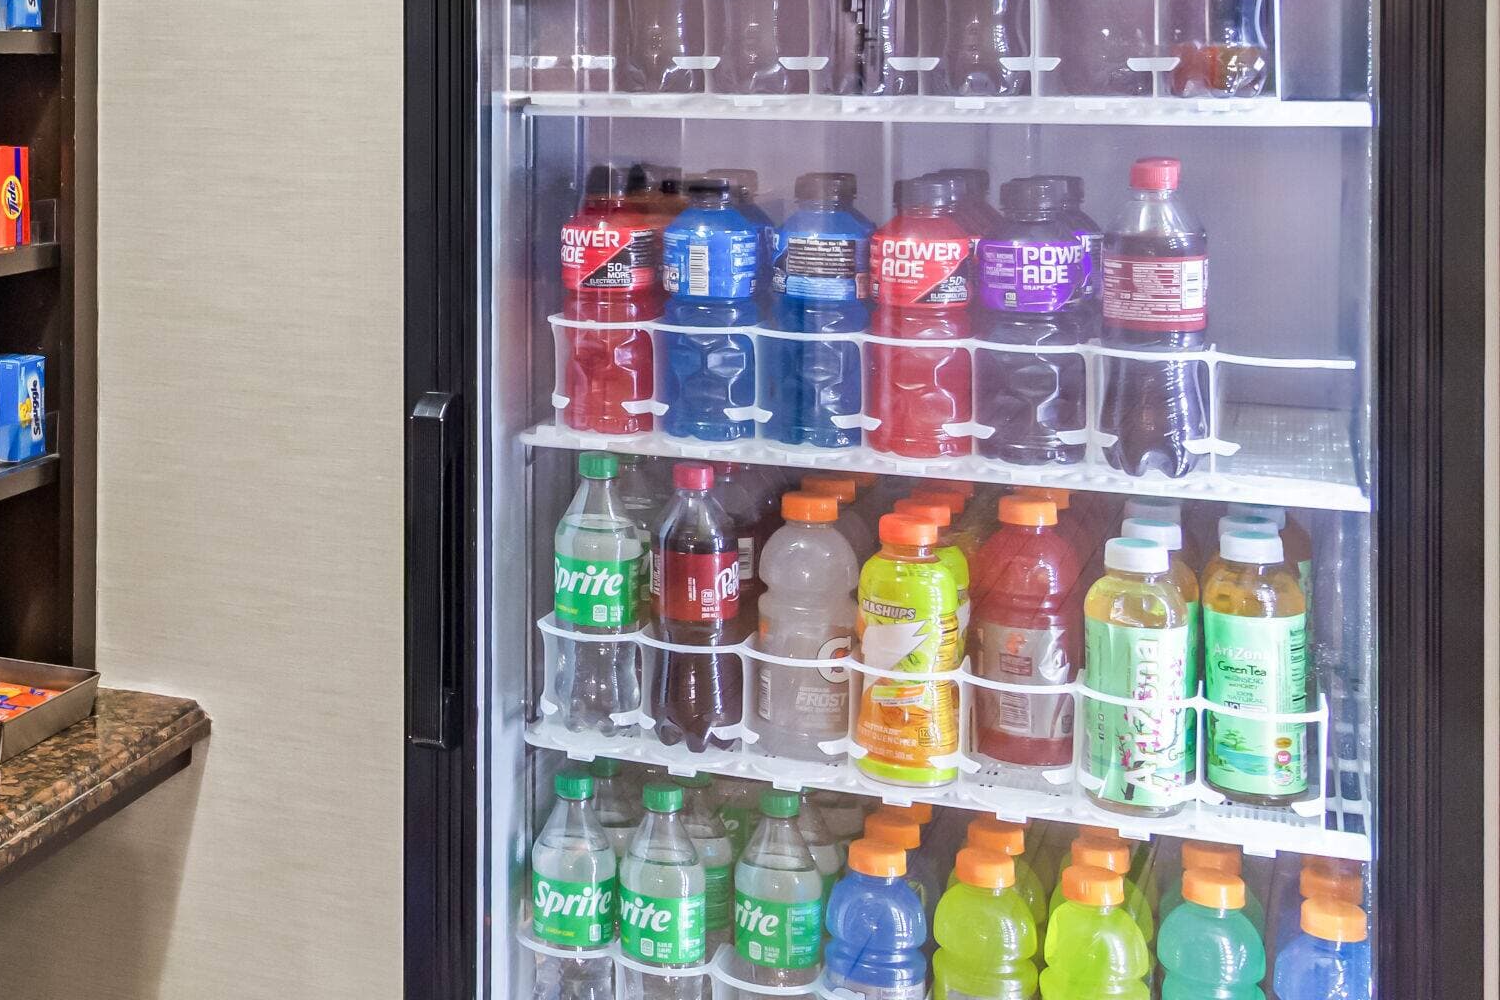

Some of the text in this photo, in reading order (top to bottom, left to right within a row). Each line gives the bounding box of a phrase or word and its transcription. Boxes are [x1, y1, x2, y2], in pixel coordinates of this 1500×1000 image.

[6, 180, 22, 216] Tide
[882, 239, 962, 262] POWER
[1022, 245, 1082, 267] POWE
[607, 271, 631, 279] MORE
[882, 257, 925, 279] ADE
[1022, 265, 1069, 285] ADE
[32, 379, 42, 437] Snuggle
[862, 599, 916, 620] MASHUPS
[1217, 660, 1267, 677] Green Tea
[534, 880, 612, 918] Sprite
[620, 895, 672, 932] rite
[734, 899, 780, 936] rite
